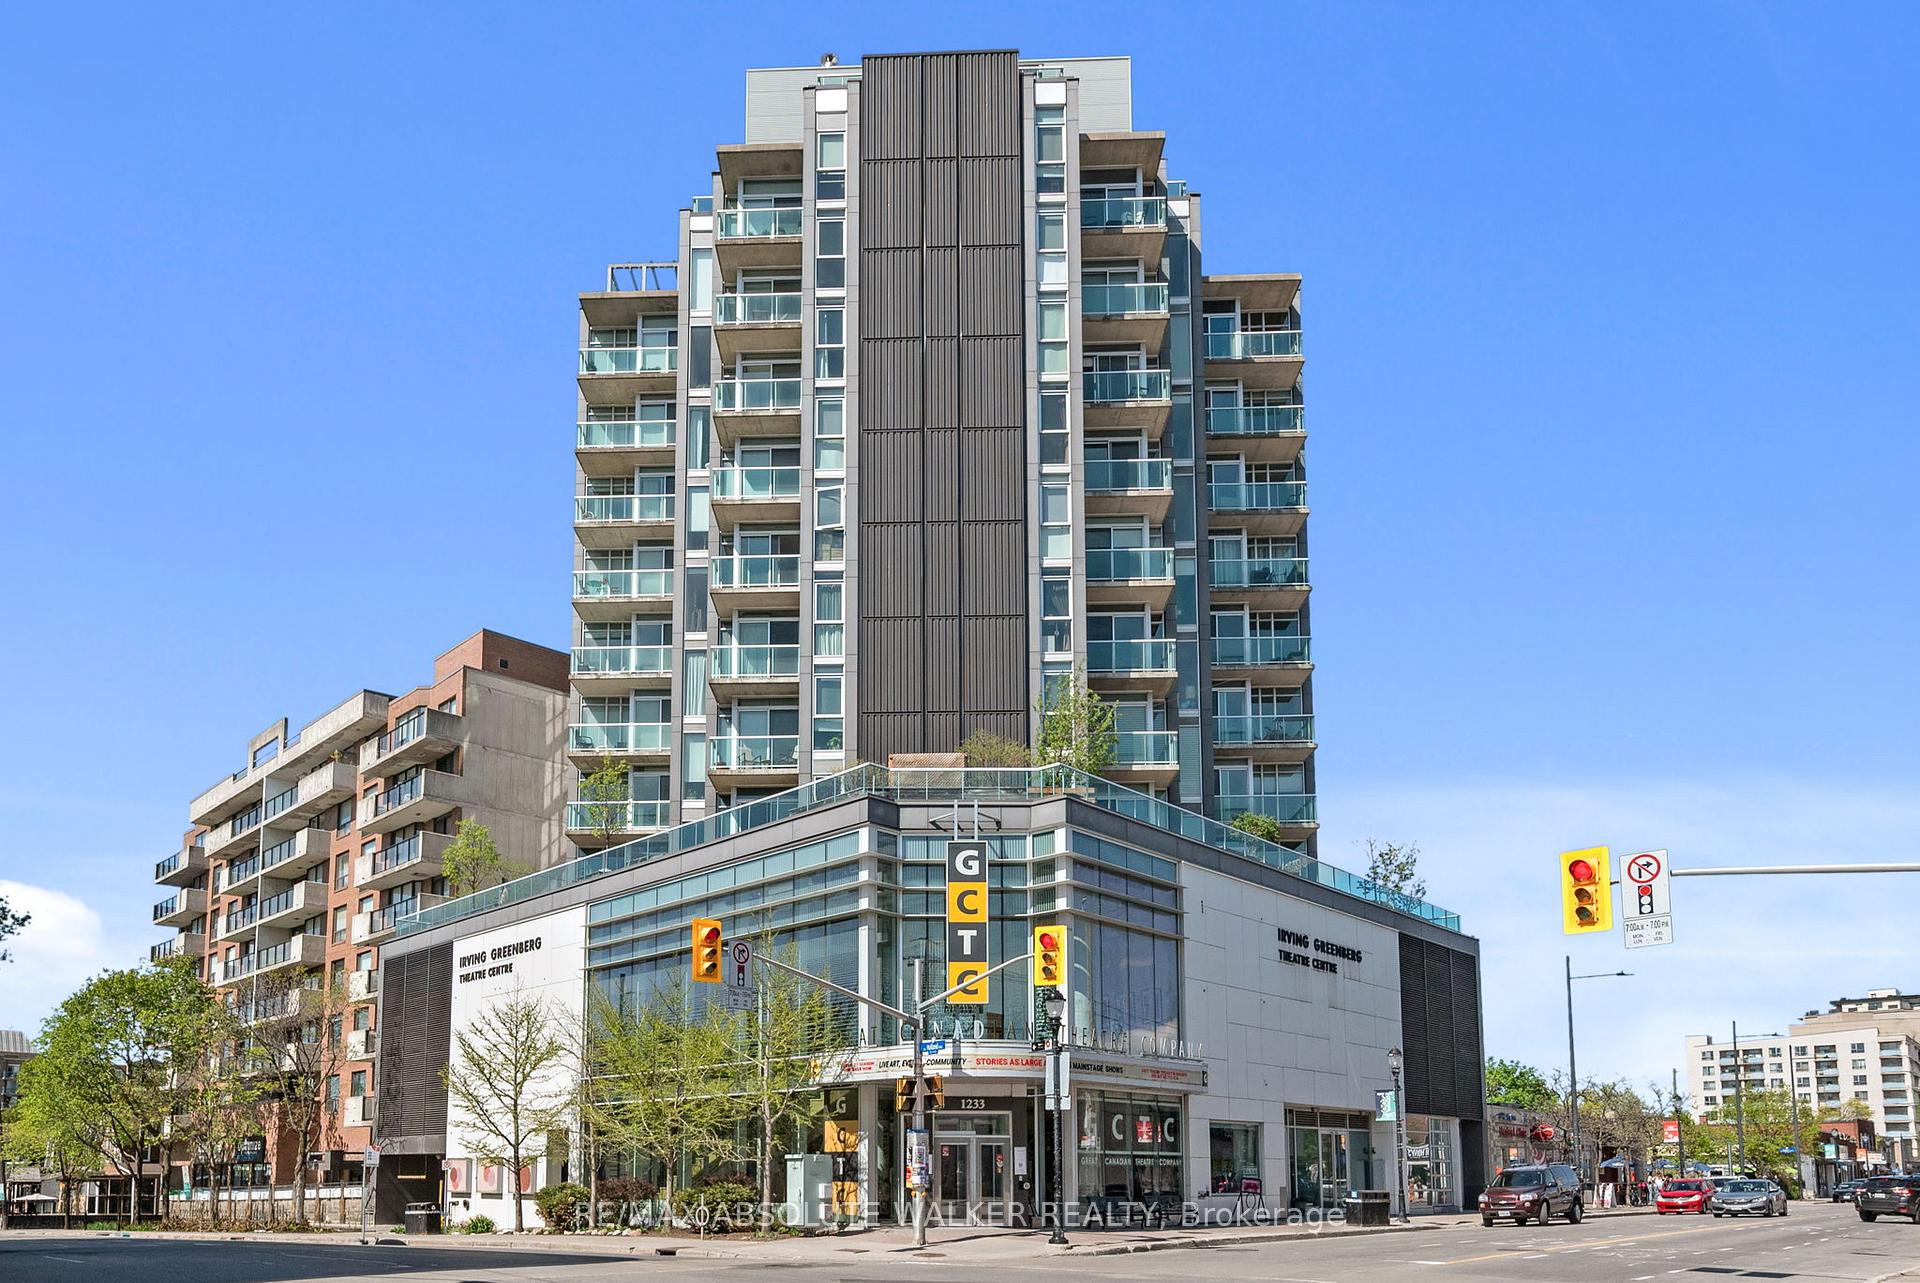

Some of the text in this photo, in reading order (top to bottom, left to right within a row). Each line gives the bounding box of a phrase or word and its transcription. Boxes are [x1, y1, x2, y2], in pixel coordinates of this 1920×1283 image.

[955, 850, 980, 995] GCTC
[459, 937, 542, 968] IRVING GREENBERG
[1277, 928, 1362, 963] IRVING GREENBERG
[459, 963, 513, 984] THEATRE CENTRE
[1278, 949, 1338, 974] THEATRE CENTRE
[901, 1020, 1034, 1042] CNADIAN
[1059, 1025, 1128, 1052] THEATRE
[1141, 1036, 1202, 1059] COMPANY
[878, 1061, 889, 1069] LIVE
[926, 1058, 967, 1067] COMMUNITY
[976, 1057, 1008, 1066] STORIES
[1010, 1058, 1020, 1066] AS
[1021, 1058, 1042, 1067] LARGE
[1072, 1062, 1103, 1072] MAINSTAGE
[1105, 1065, 1123, 1074] SHOWS
[961, 1099, 985, 1110] 1233
